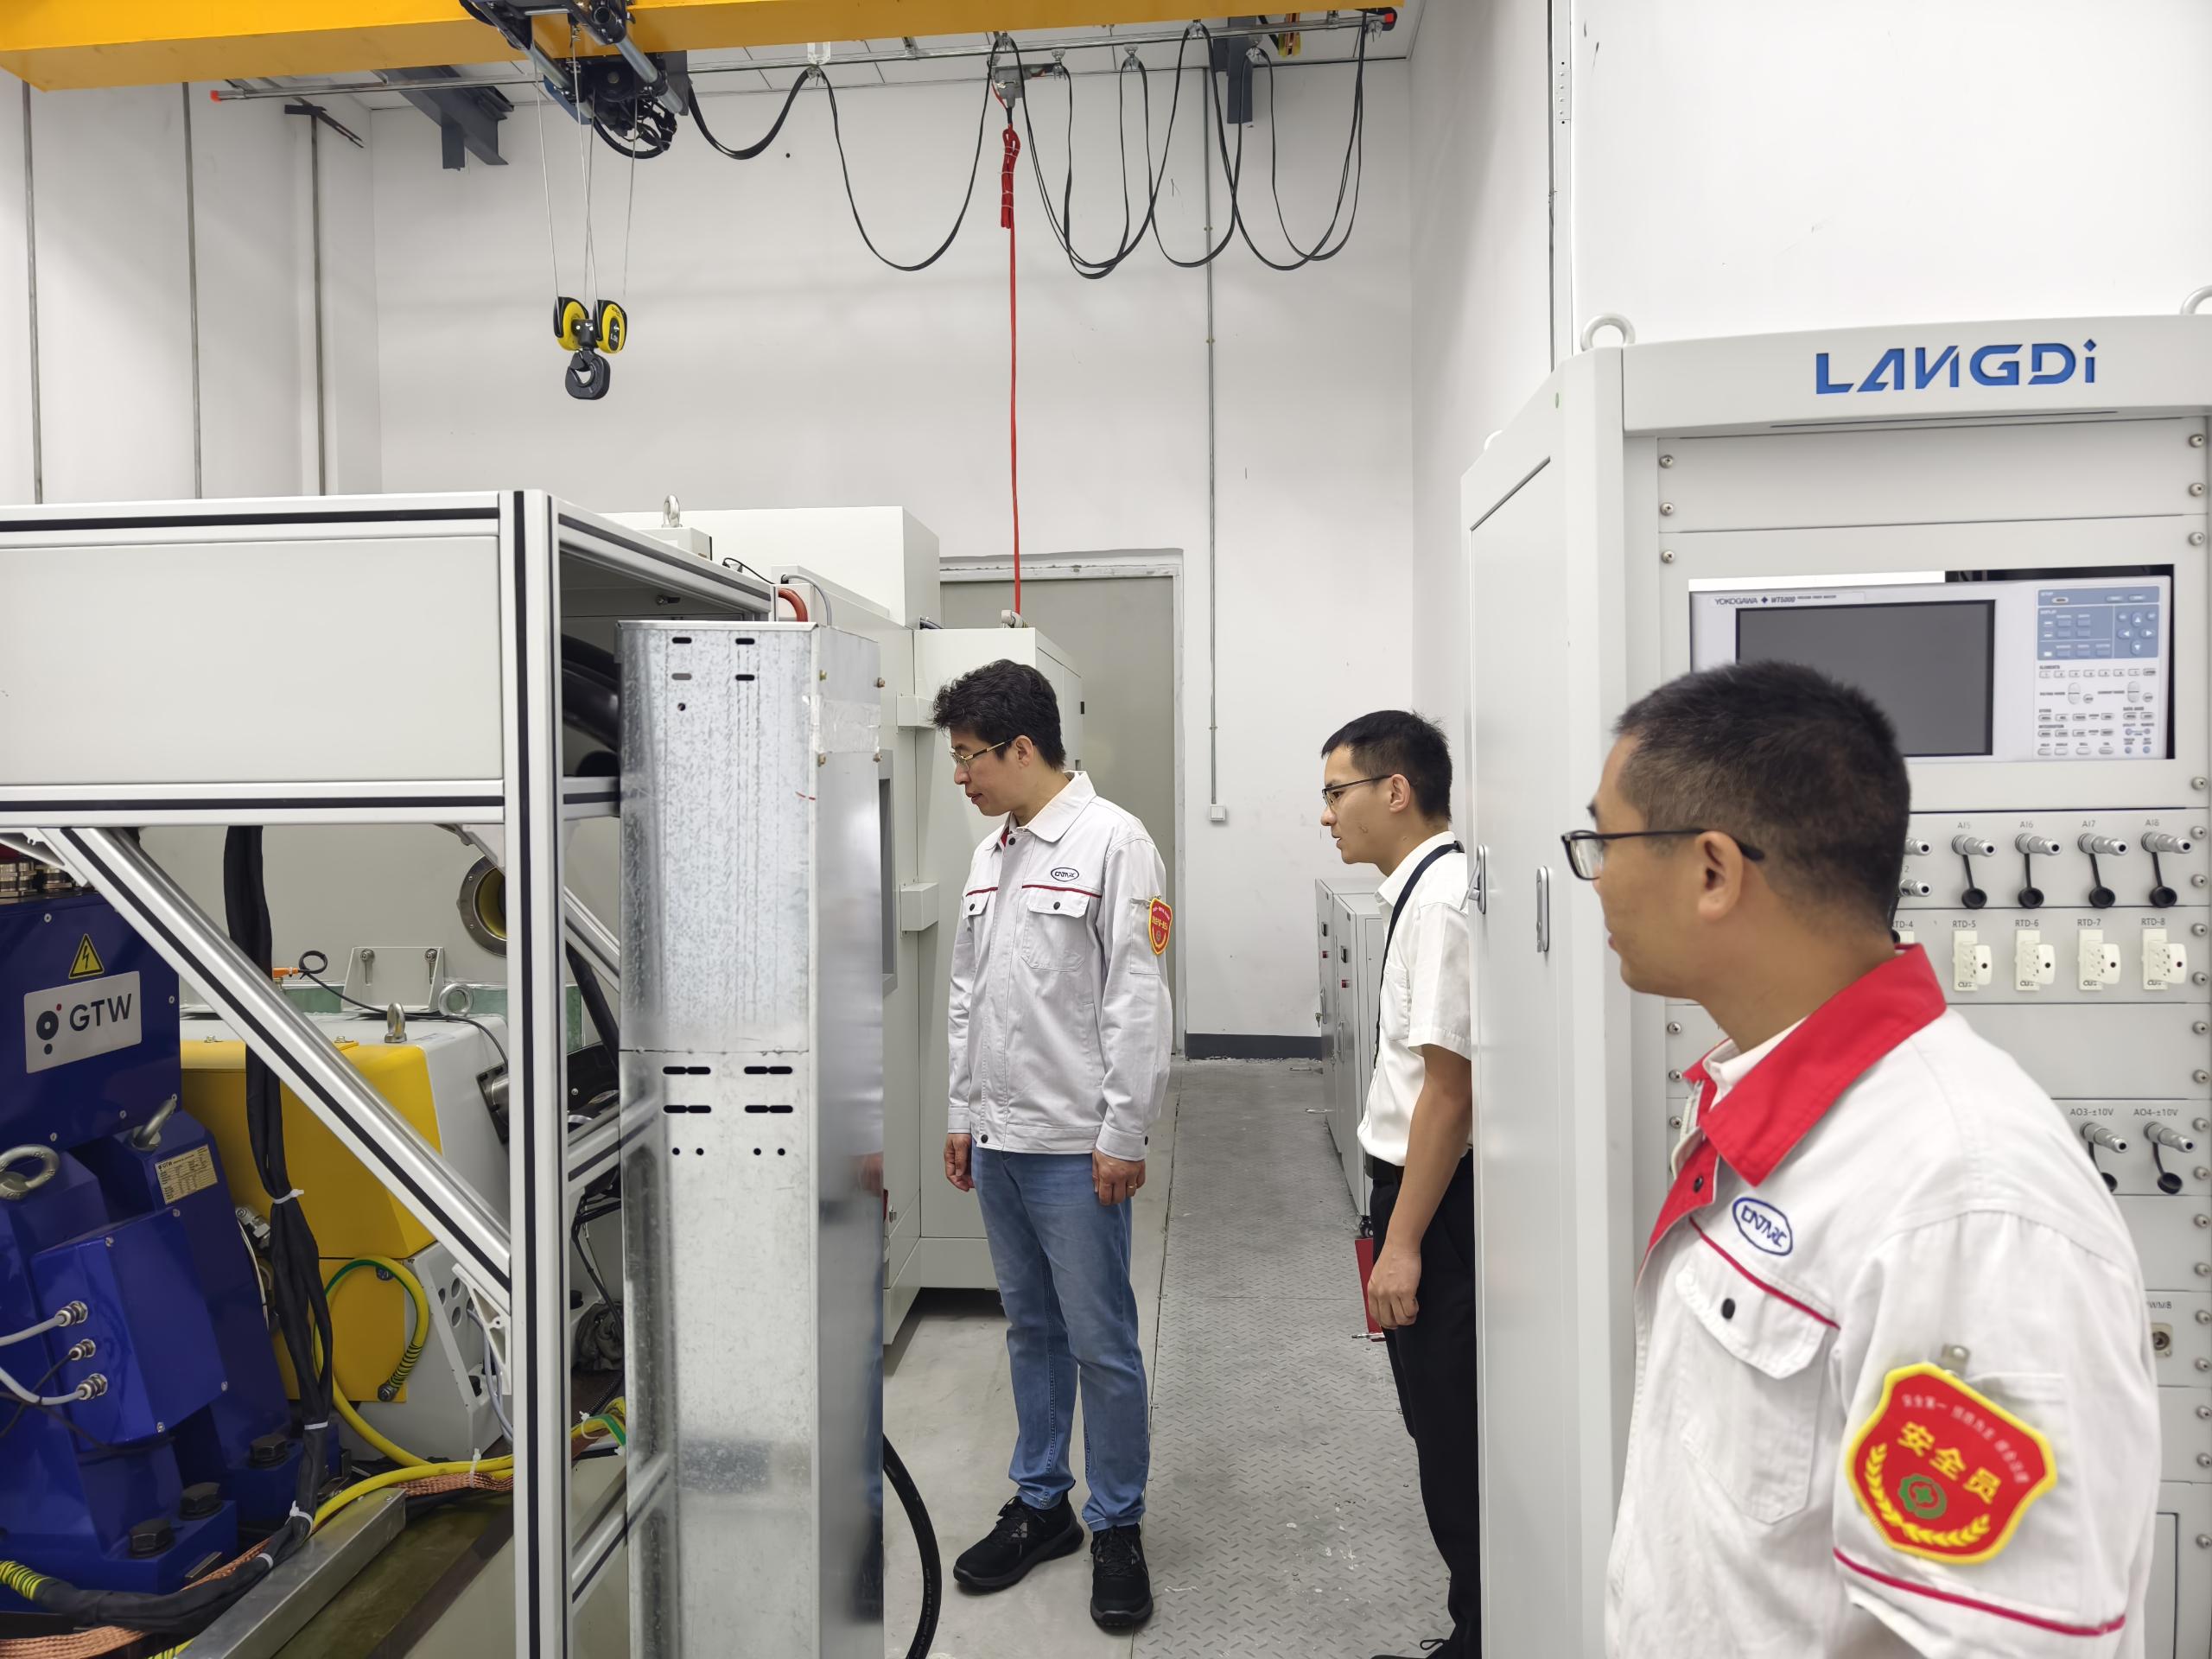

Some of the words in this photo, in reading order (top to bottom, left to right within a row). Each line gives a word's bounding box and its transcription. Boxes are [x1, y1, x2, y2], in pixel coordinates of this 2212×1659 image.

[1714, 597, 1758, 606] YOKOGAWA
[1952, 919, 1977, 928] RTD-5
[69, 993, 132, 1032] GTW
[2069, 1108, 2114, 1116] AO3-±10V
[2133, 1108, 2179, 1116] AO4-±10V
[1897, 1421, 2002, 1505] 安全员
